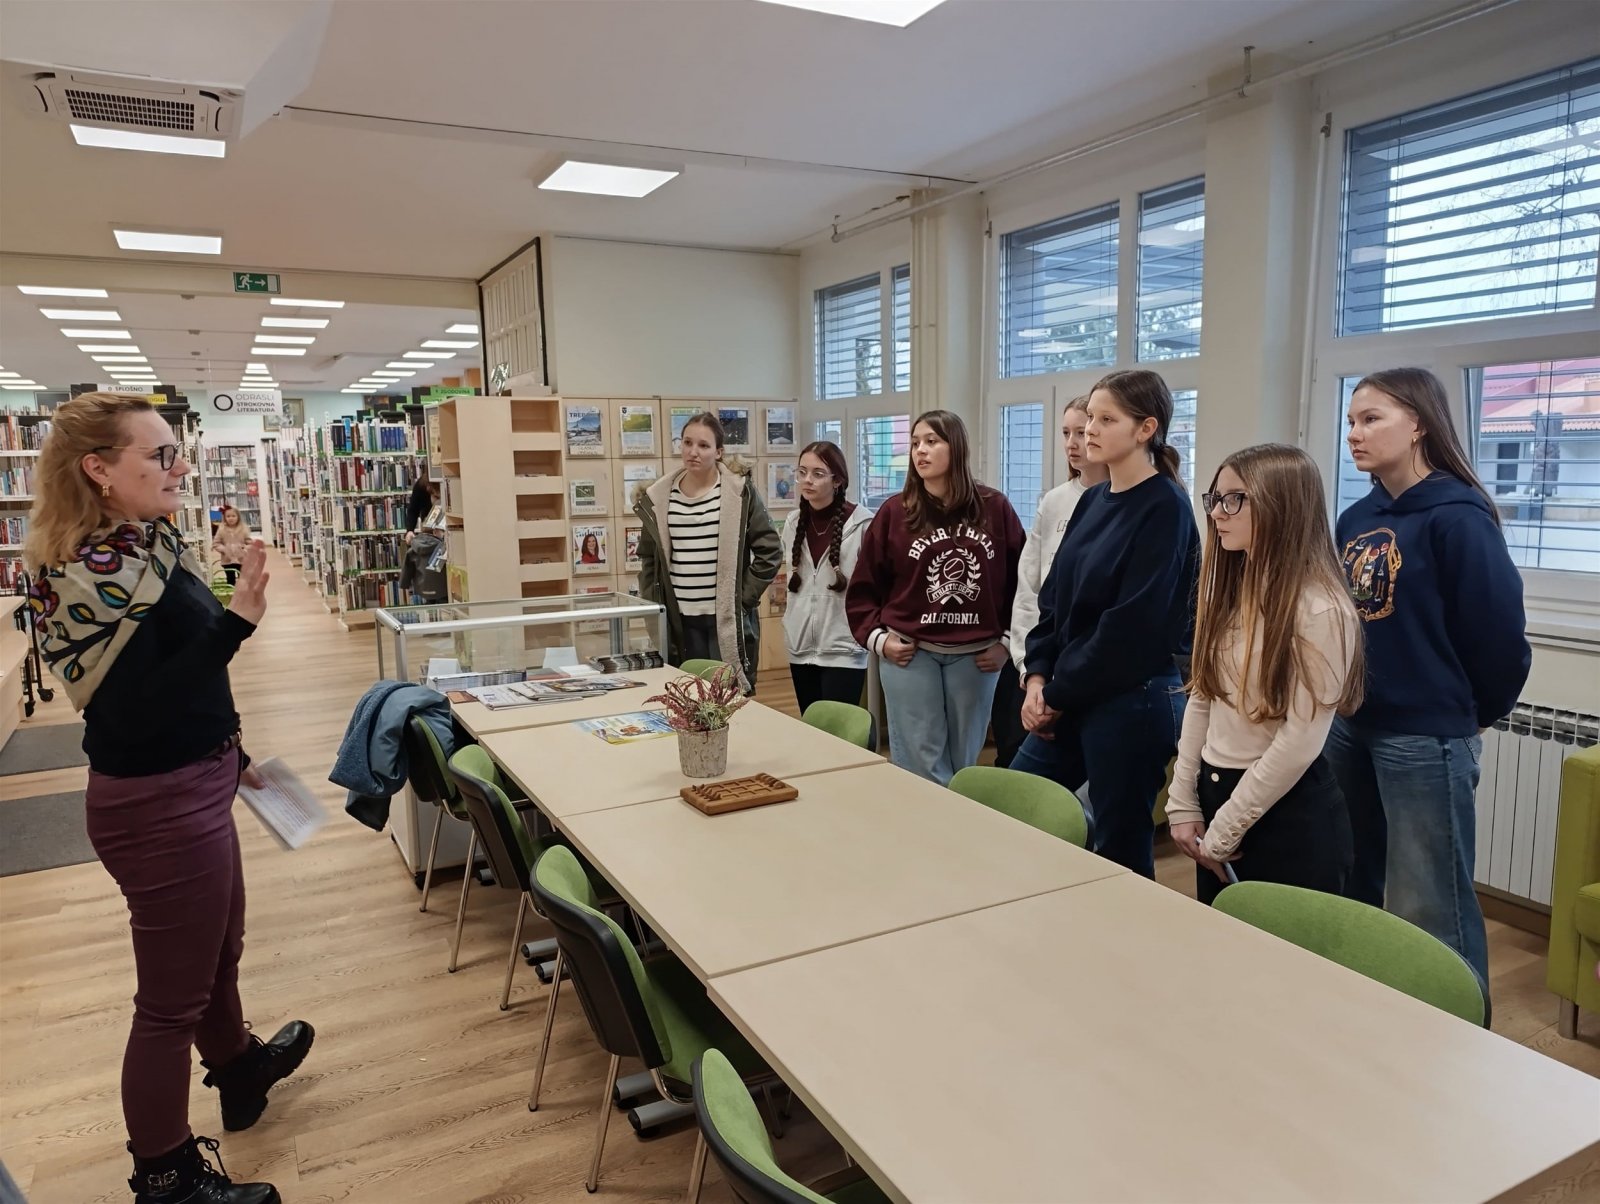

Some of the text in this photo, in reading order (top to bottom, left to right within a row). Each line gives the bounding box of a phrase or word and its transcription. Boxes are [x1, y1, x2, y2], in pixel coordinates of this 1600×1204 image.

[235, 393, 274, 401] ODRASLI
[908, 523, 963, 560] BEVERY
[920, 612, 980, 625] CALIFORNIA
